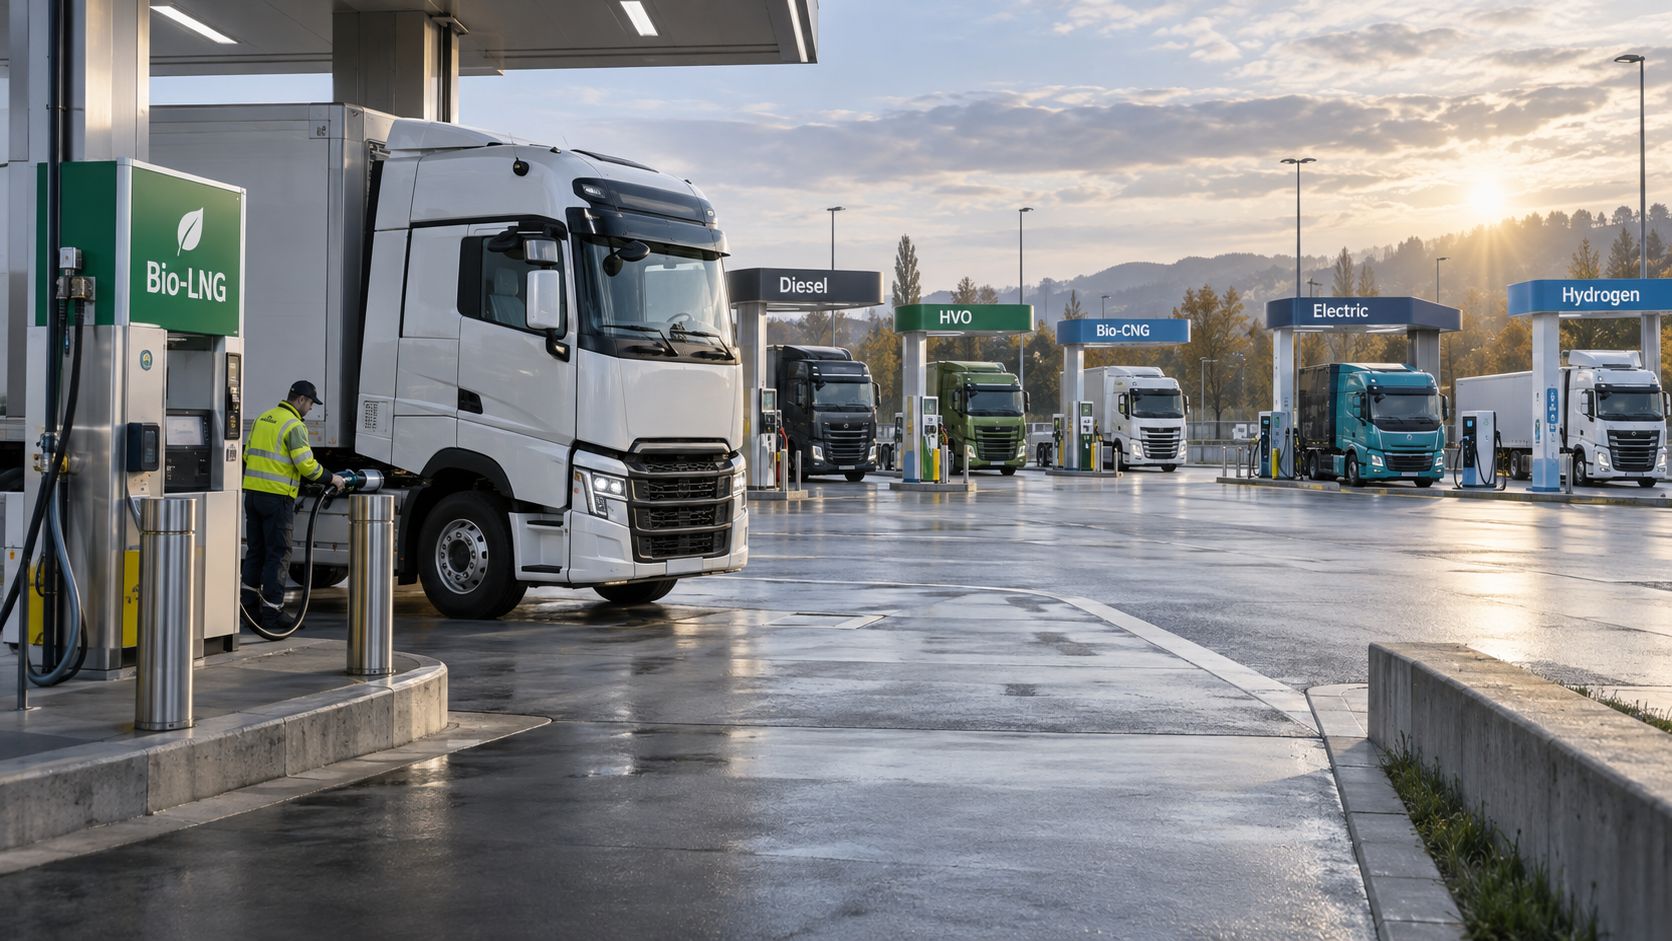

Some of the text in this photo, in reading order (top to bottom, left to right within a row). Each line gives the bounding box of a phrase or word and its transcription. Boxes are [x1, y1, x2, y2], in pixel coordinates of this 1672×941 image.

[146, 260, 226, 303] Bio-LNG
[779, 276, 828, 294] Diesel
[1562, 287, 1640, 306] Hydrogen
[939, 309, 972, 325] HVO
[1313, 303, 1369, 318] Electric
[1096, 323, 1150, 337] Bio-CNG
